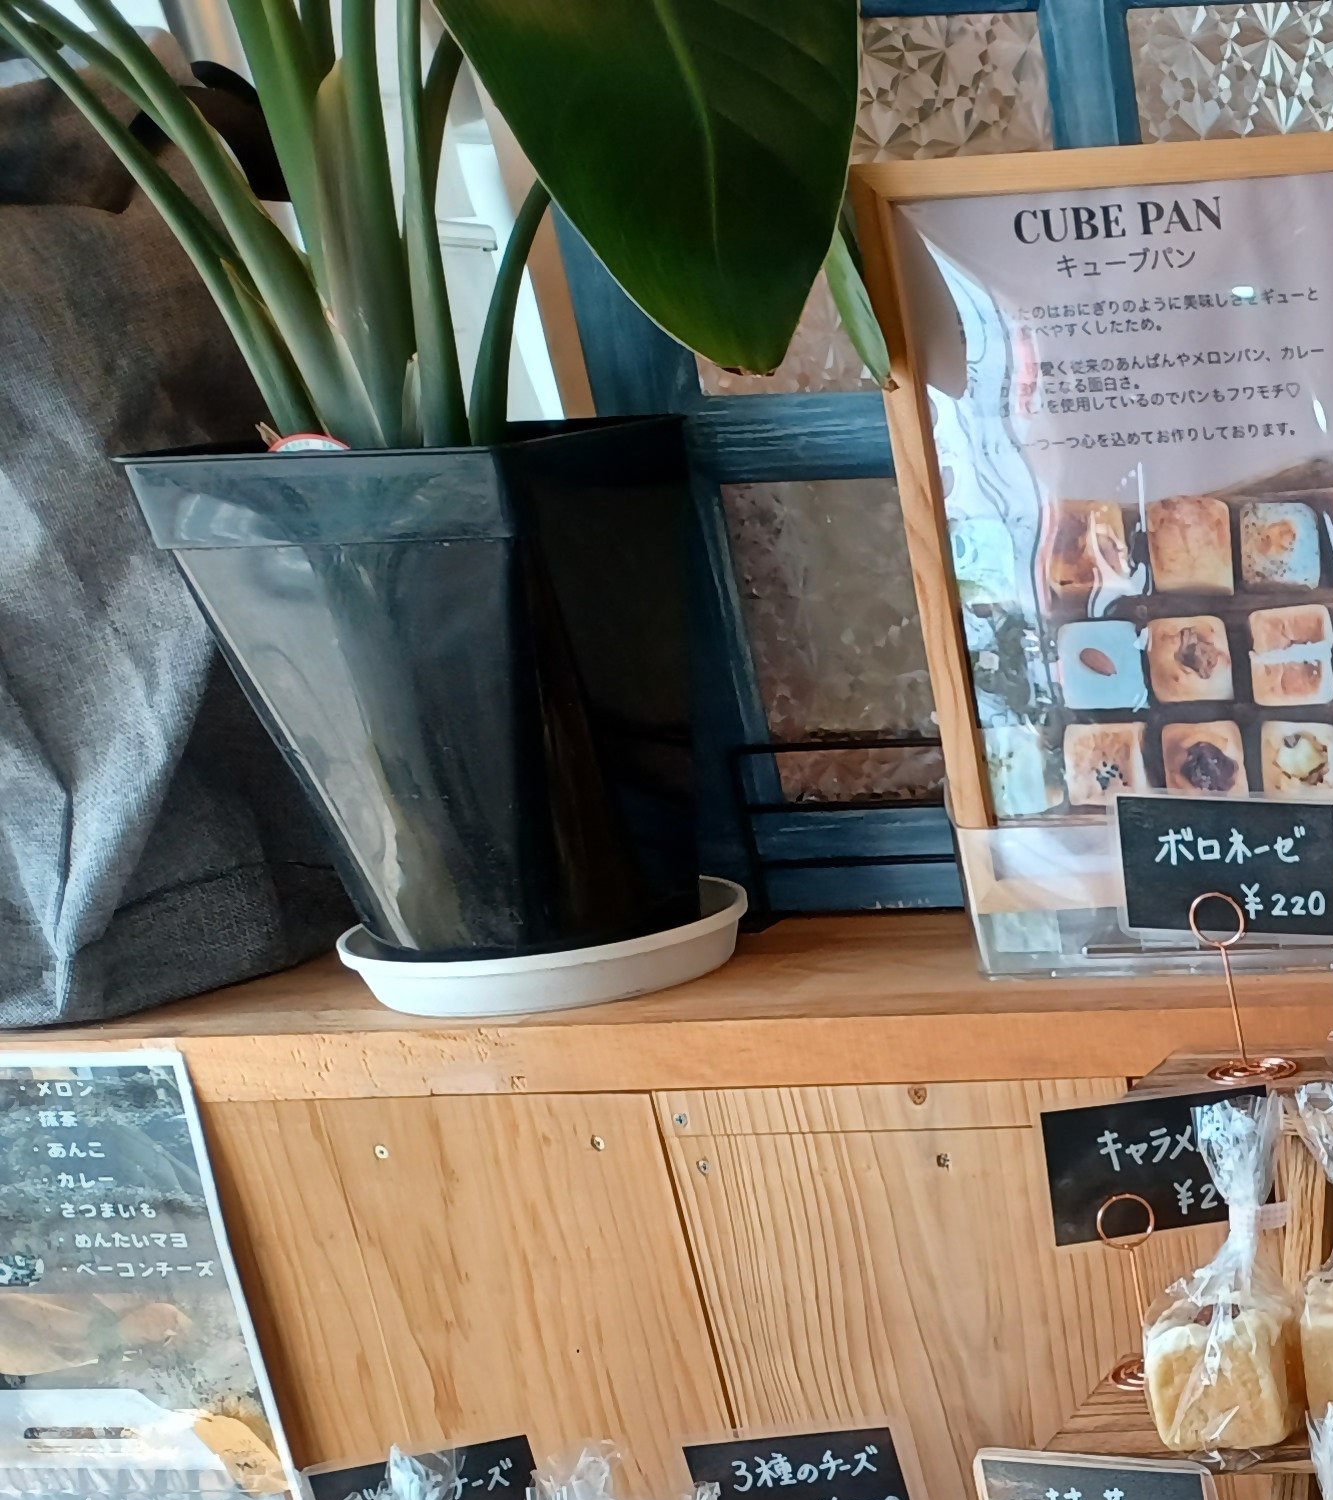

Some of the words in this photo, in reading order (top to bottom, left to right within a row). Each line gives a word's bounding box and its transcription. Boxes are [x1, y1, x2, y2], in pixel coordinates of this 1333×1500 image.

[1013, 203, 1127, 245] CUBE
[1137, 196, 1223, 236] PAN
[1056, 246, 1197, 278] キューブパン
[1154, 825, 1307, 866] ボロネーゼ
[1239, 882, 1326, 920] ¥220
[36, 1081, 94, 1097] メロン
[46, 1141, 106, 1158] あんこ
[1096, 1124, 1199, 1172] キャラメ
[57, 1171, 114, 1189] カレー
[60, 1201, 157, 1218] さつまいも
[74, 1231, 189, 1249] めんたいマヨ
[76, 1259, 215, 1278] ベーコンチーズ
[730, 1443, 879, 1492] 3種のチーズ
